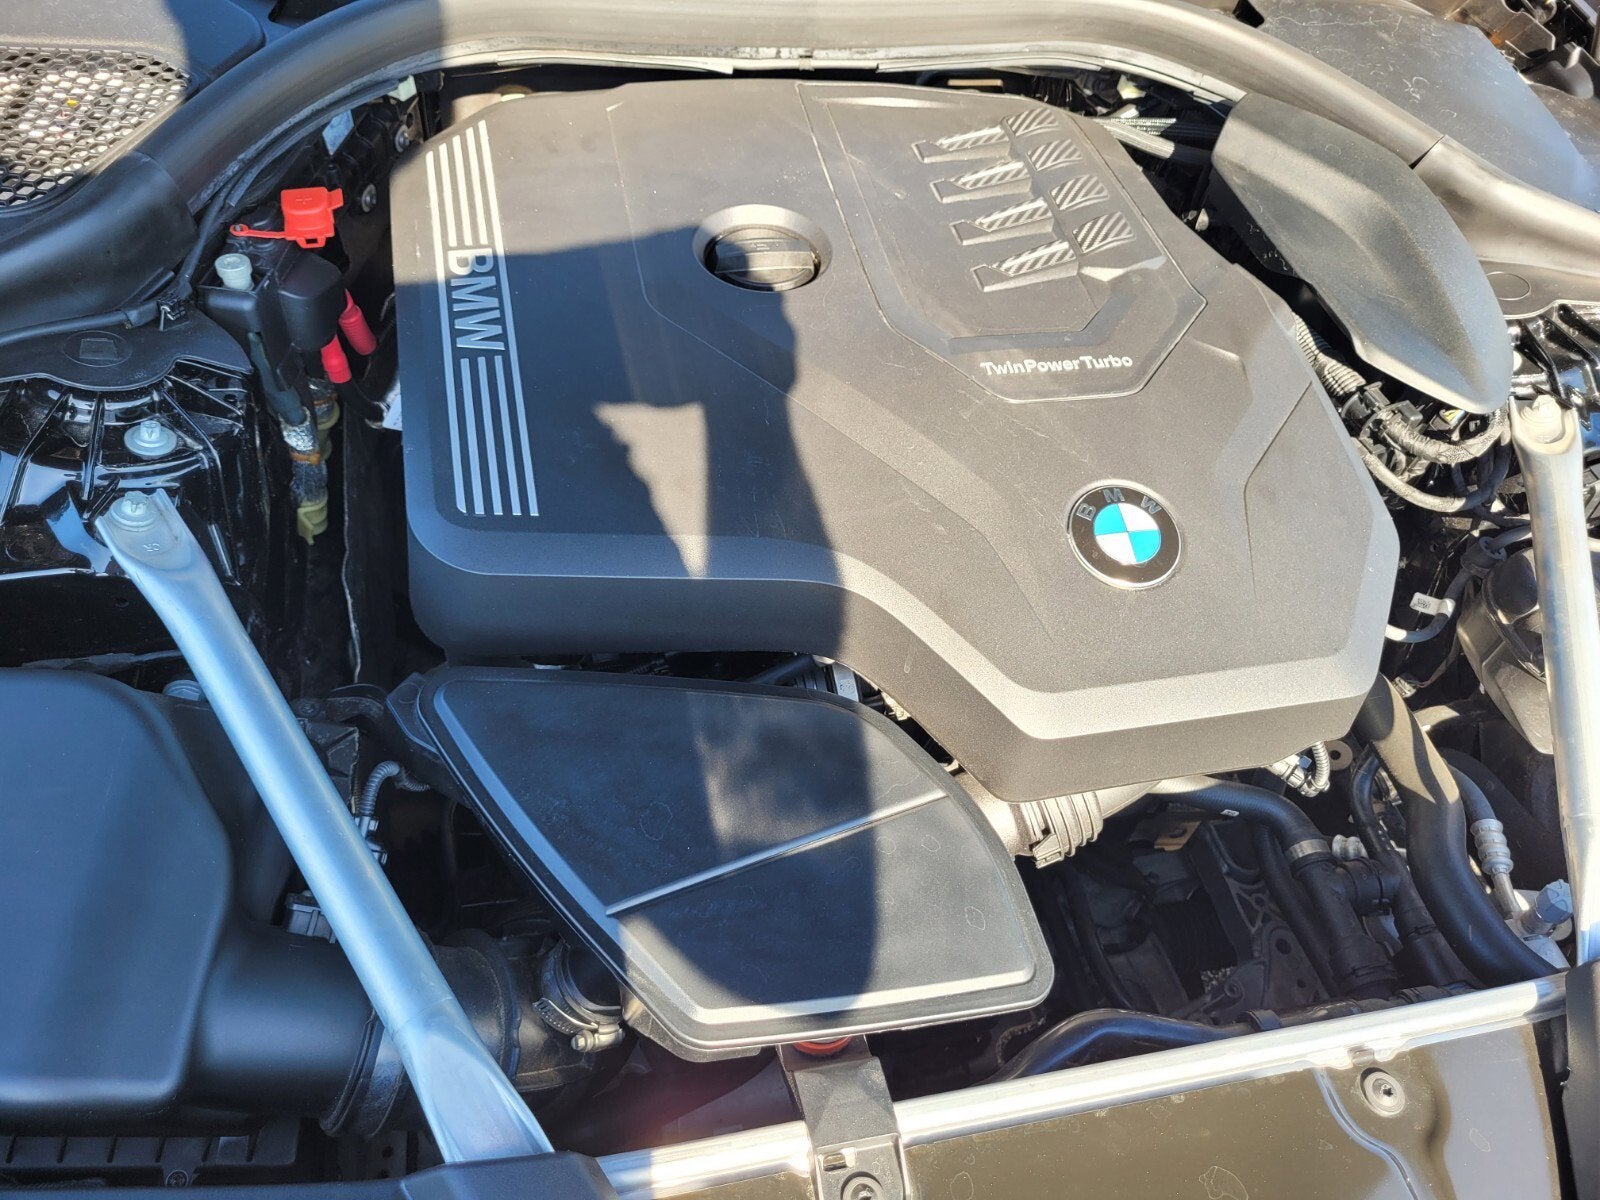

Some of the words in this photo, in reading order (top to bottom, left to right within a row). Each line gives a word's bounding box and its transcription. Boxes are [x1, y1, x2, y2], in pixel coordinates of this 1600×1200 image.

[447, 247, 505, 351] BMW
[979, 358, 1080, 376] TwinPower
[1079, 354, 1133, 369] Turbo
[1076, 487, 1162, 521] BMW
